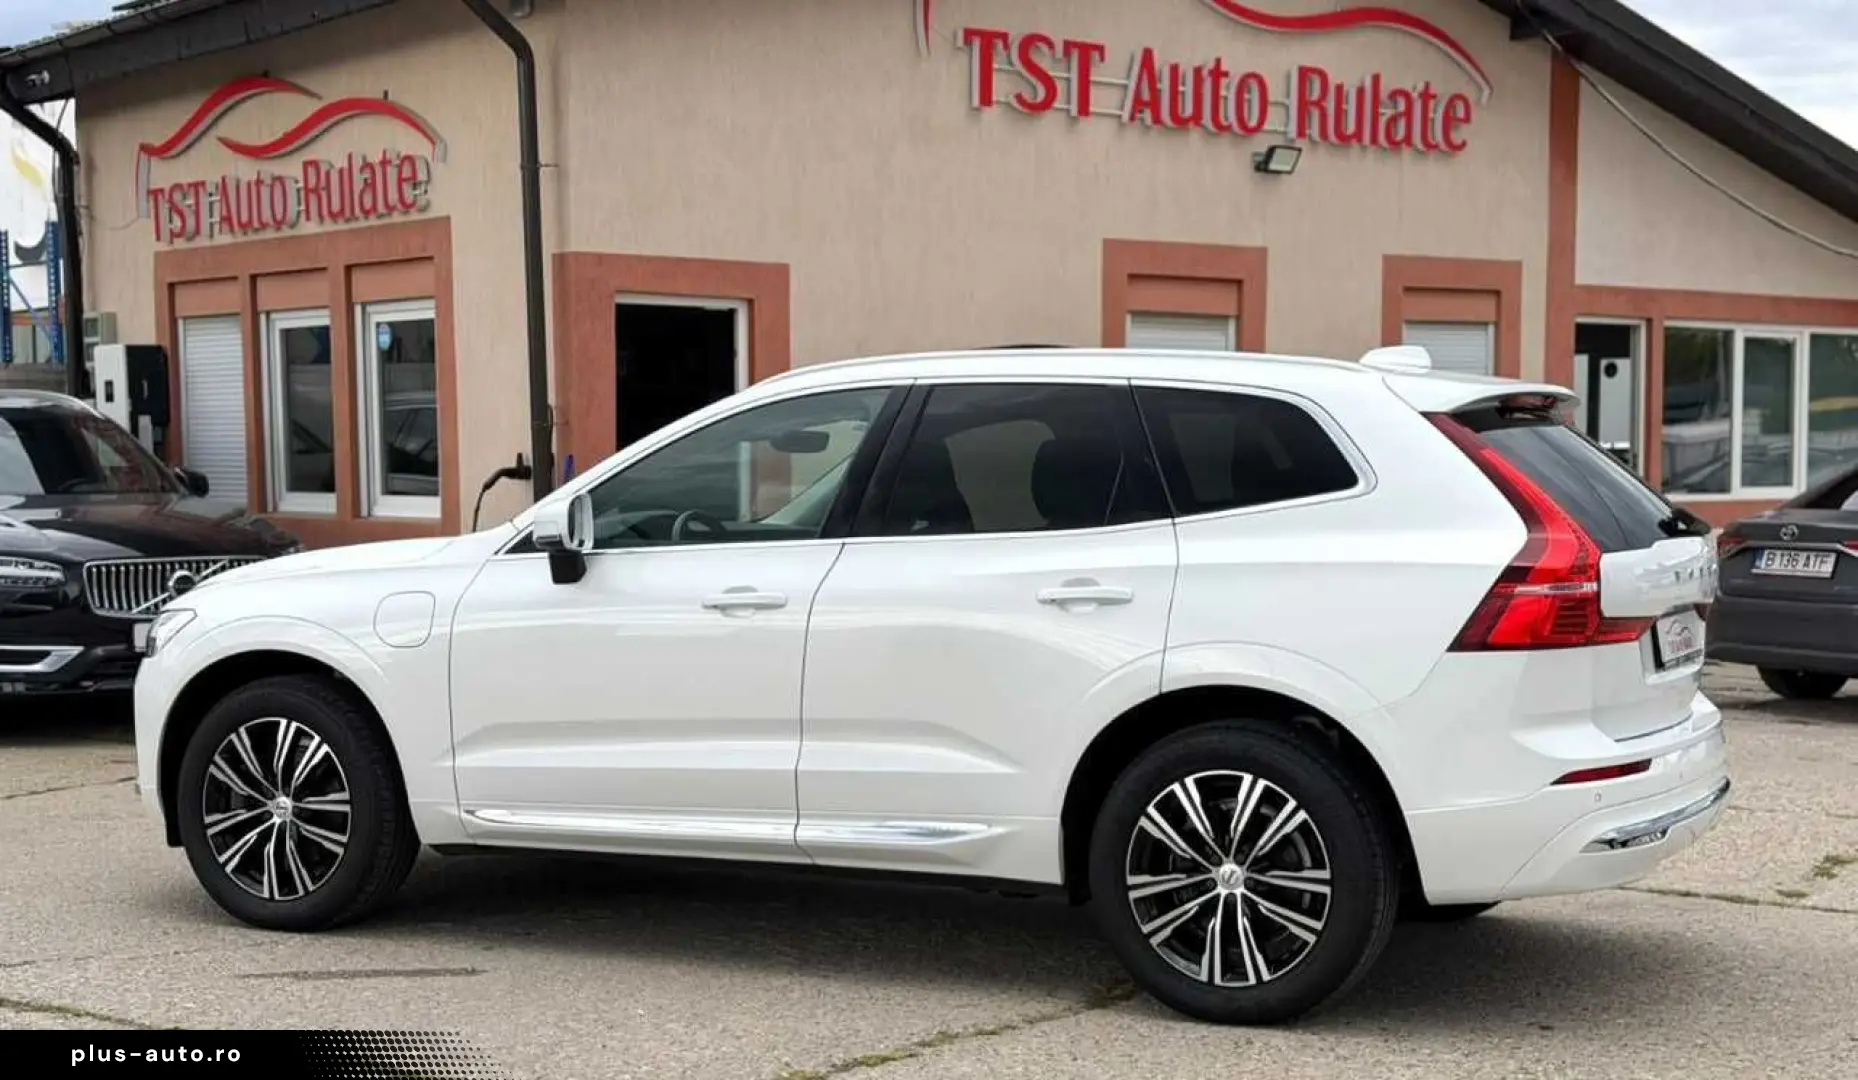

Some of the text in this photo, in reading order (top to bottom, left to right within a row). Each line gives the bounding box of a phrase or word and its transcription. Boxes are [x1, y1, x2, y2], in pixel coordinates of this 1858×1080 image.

[961, 26, 1473, 153] TST Auto Rulate
[147, 148, 418, 242] TST Auto Rulate
[1765, 551, 1777, 567] B
